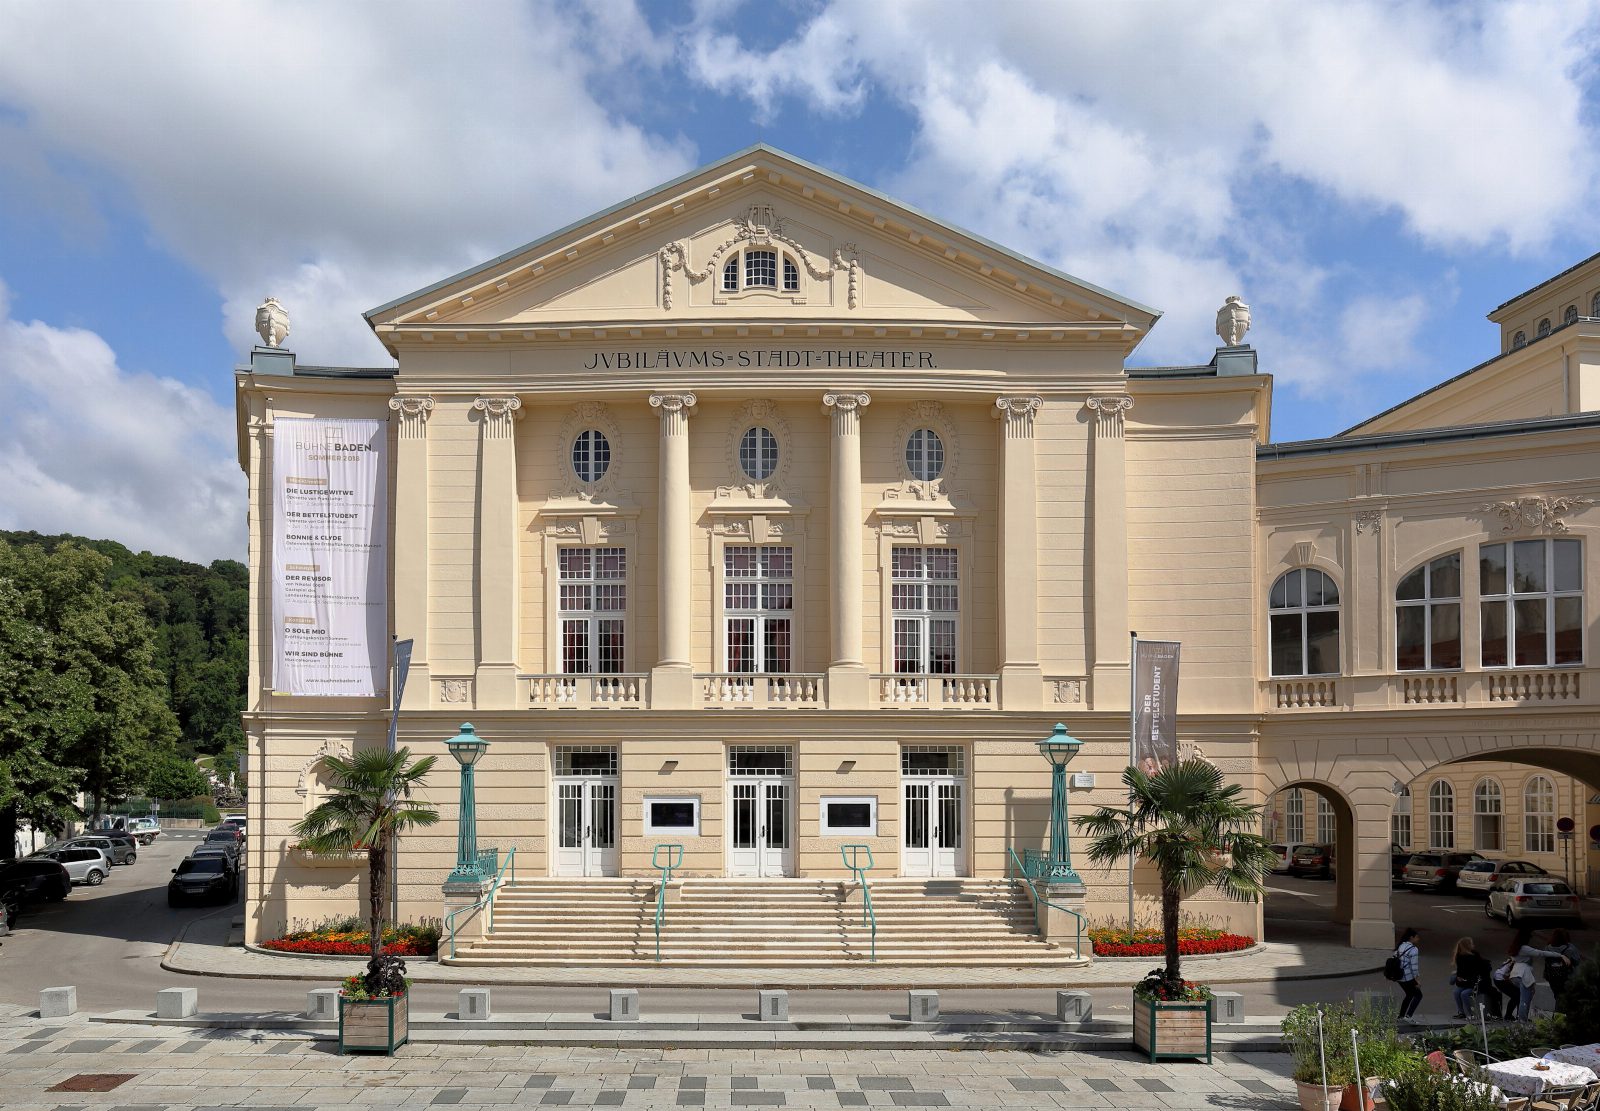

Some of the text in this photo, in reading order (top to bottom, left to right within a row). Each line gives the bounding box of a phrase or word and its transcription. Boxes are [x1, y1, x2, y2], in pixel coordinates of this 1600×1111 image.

[334, 443, 372, 452] BADEN
[308, 454, 342, 462] SOMMER
[1144, 694, 1152, 713] DER
[1151, 666, 1162, 741] BETTELSTUDENT
